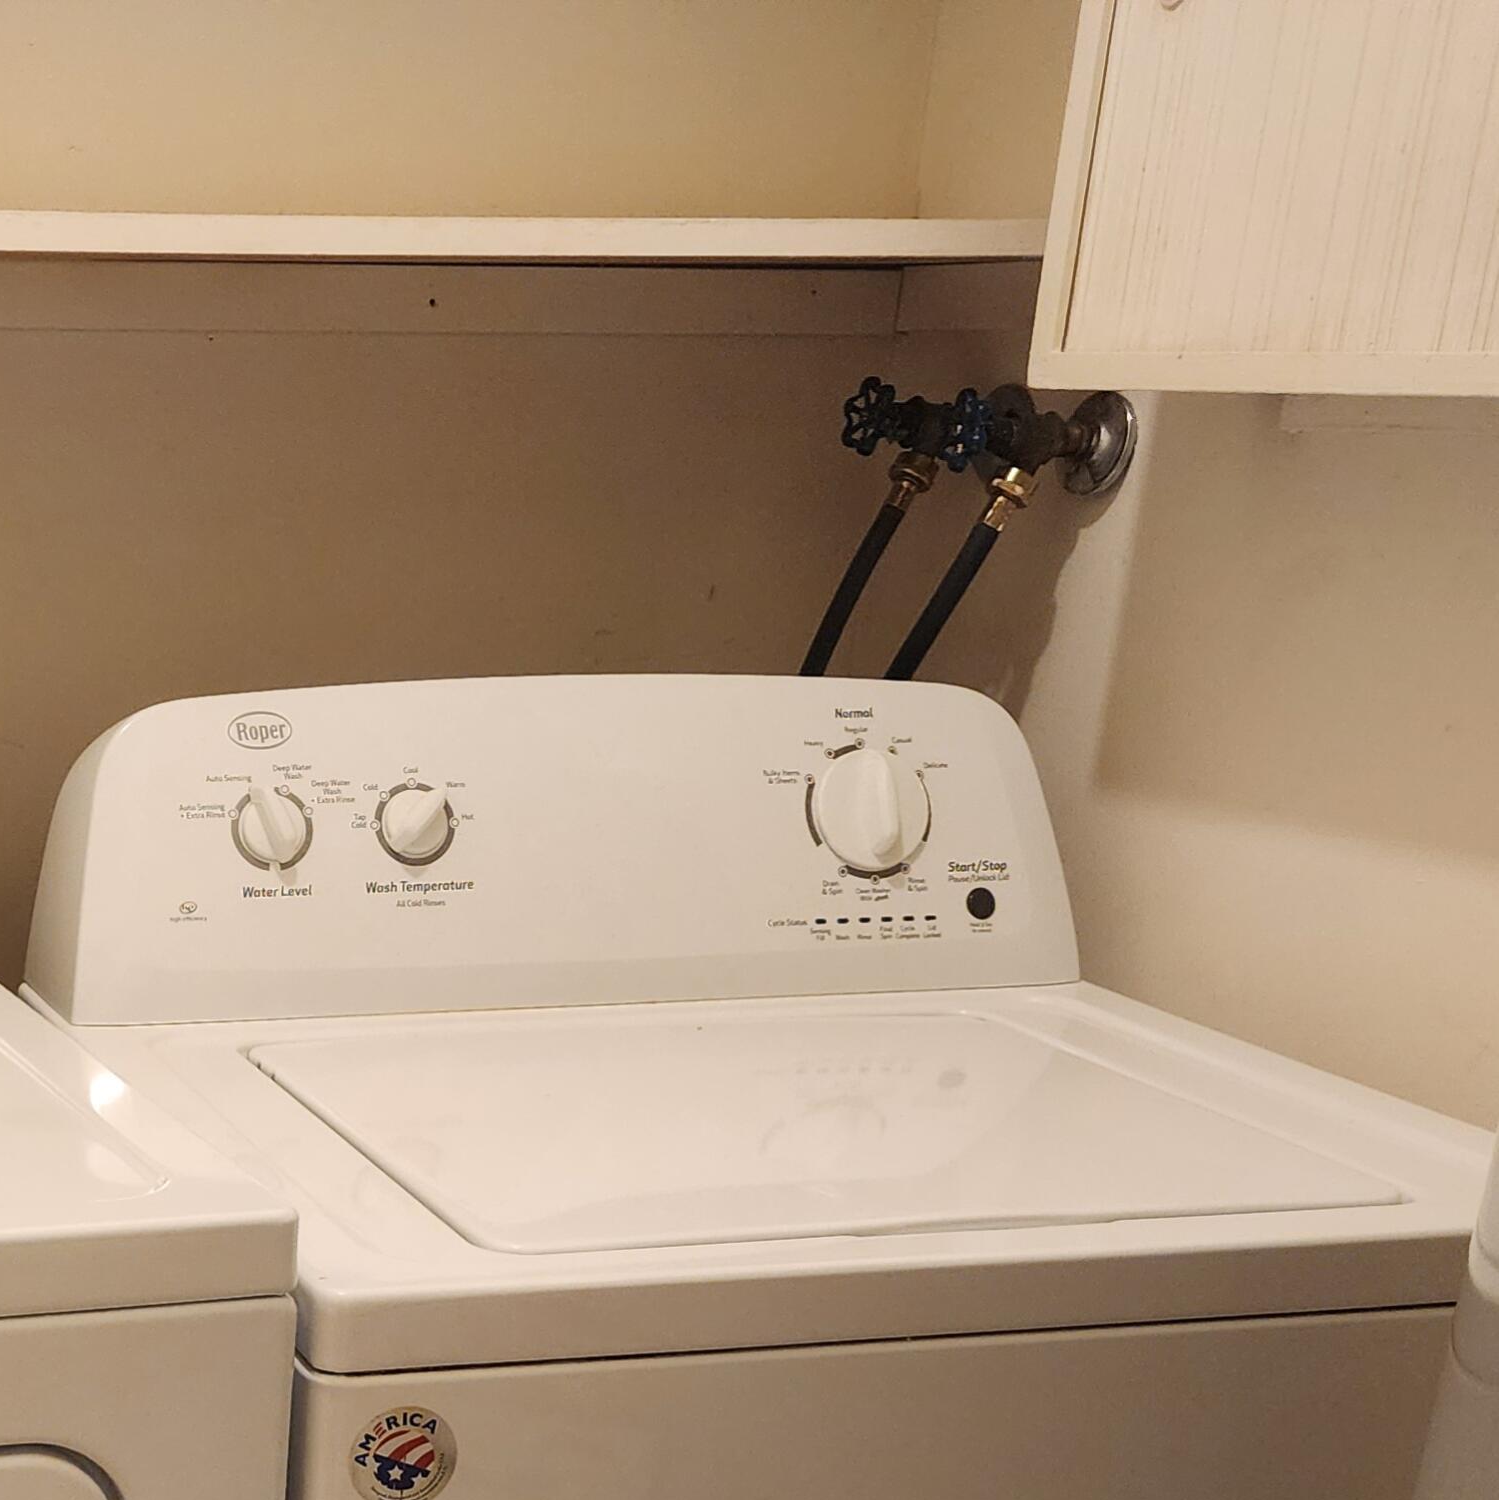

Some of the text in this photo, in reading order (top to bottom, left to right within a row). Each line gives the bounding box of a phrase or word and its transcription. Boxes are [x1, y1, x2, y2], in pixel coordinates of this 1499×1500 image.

[835, 707, 874, 719] Normal
[235, 722, 286, 743] Roper
[223, 774, 252, 783] Sensing
[362, 783, 379, 791] Cold
[351, 821, 367, 829] Cold
[947, 860, 1008, 873] Start/Stop
[242, 884, 313, 899] Water Level
[365, 880, 474, 895] Wash Temperature
[354, 1411, 438, 1468] AMERICA
